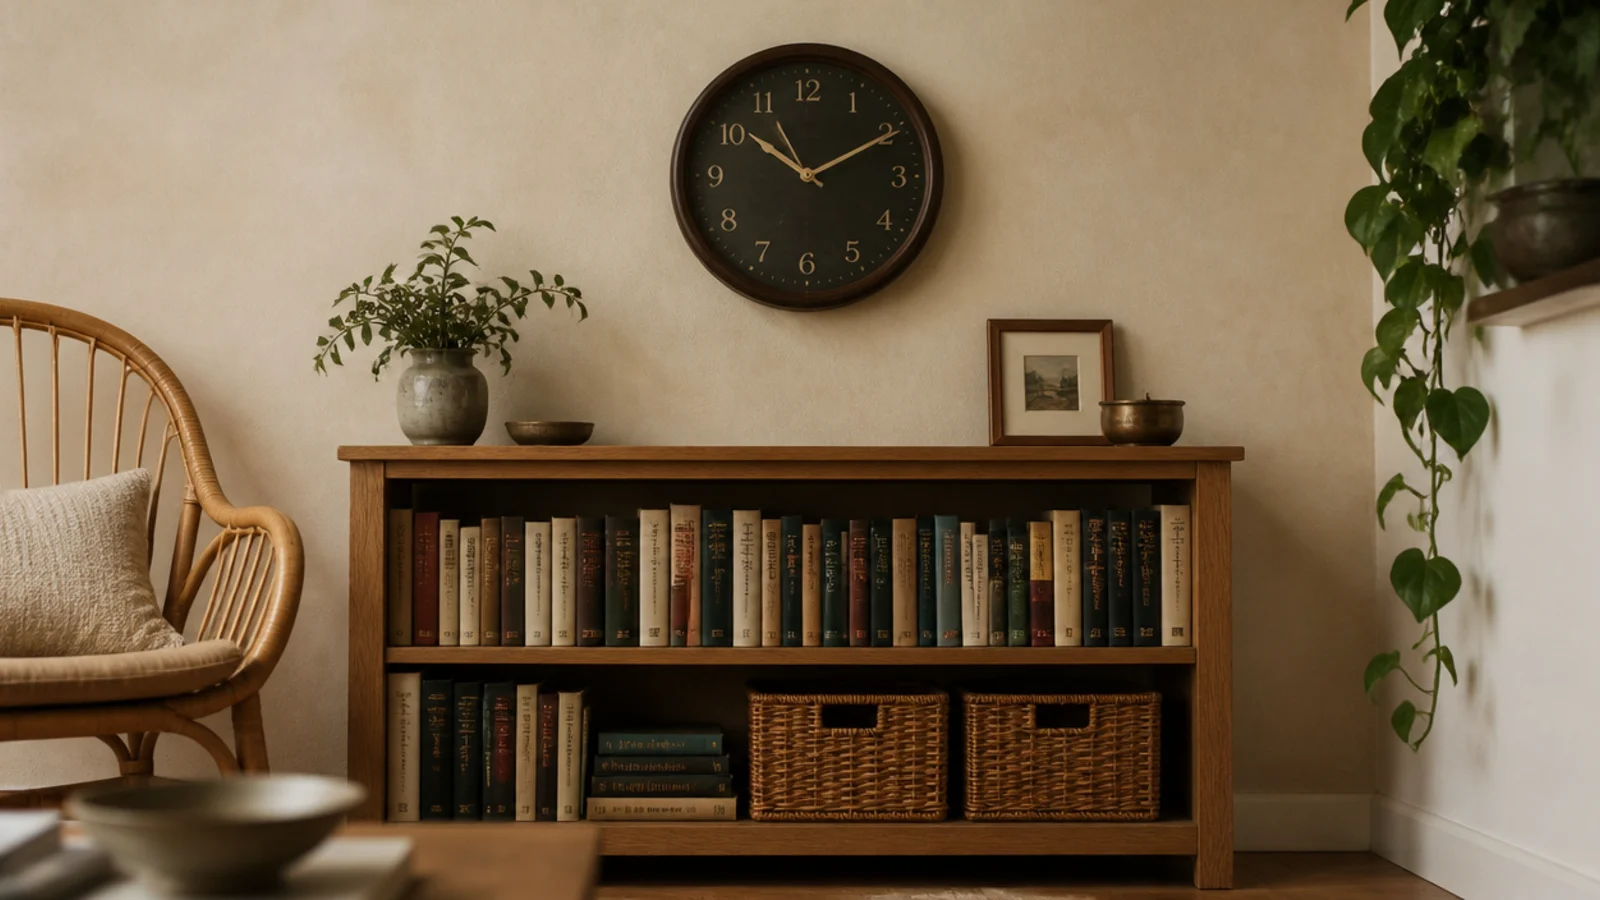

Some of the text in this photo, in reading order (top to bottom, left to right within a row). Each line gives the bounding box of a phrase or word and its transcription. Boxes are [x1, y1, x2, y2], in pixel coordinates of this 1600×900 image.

[795, 79, 821, 102] 12
[753, 92, 773, 113] 11
[849, 92, 857, 113] 1
[720, 123, 745, 145] 10
[878, 123, 894, 146] 2
[707, 165, 723, 187] 9
[891, 166, 906, 188] 3
[721, 209, 737, 231] 8
[876, 209, 892, 230] 4
[755, 241, 770, 263] 7
[845, 241, 860, 262] 5
[799, 252, 815, 275] 6
